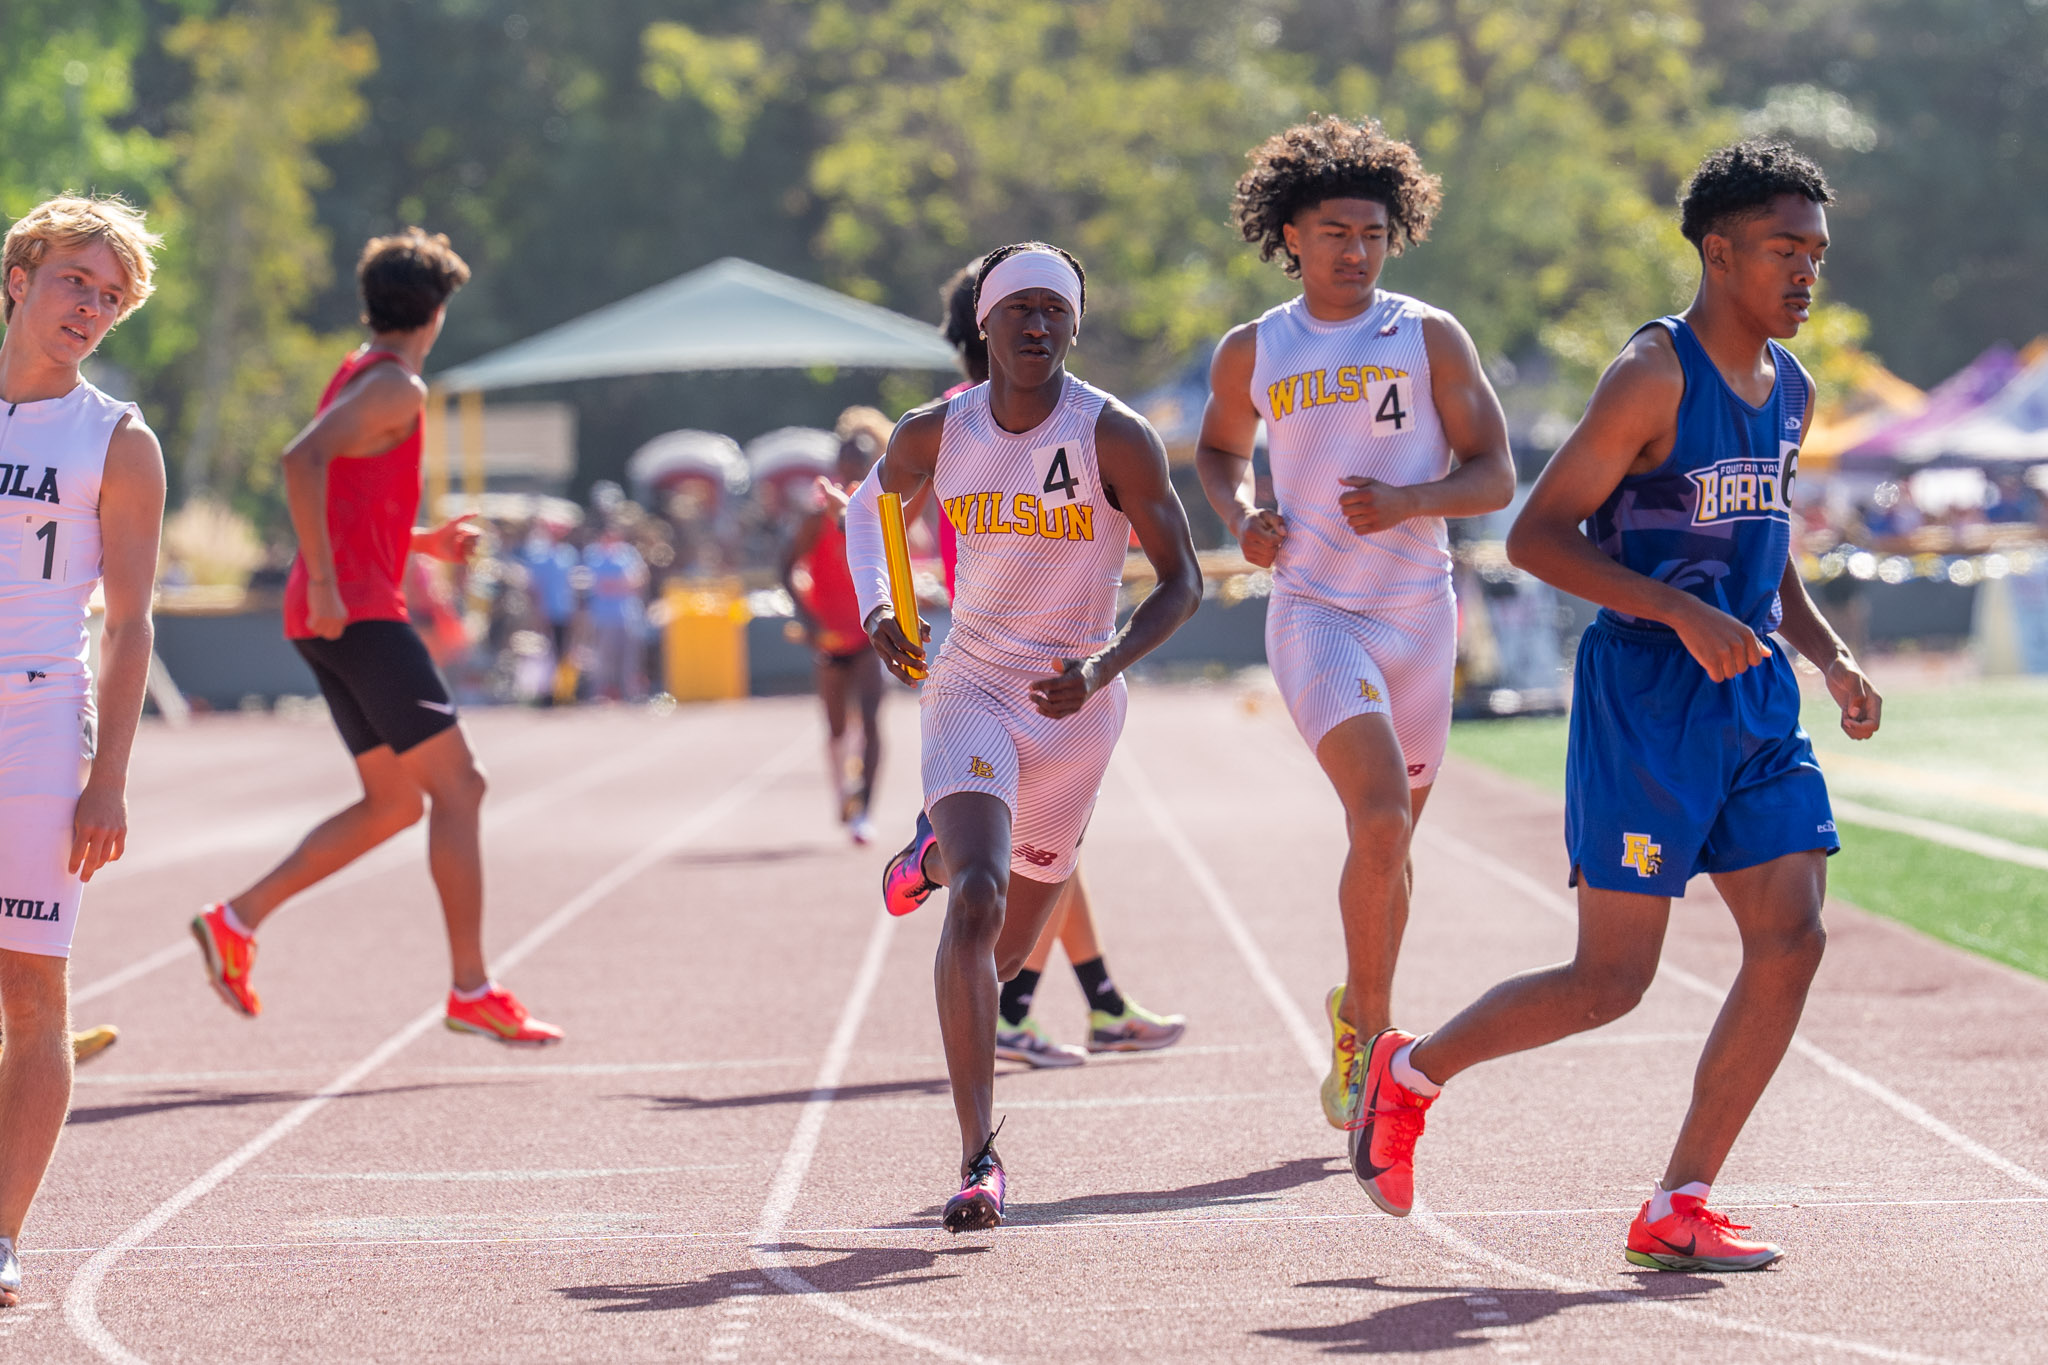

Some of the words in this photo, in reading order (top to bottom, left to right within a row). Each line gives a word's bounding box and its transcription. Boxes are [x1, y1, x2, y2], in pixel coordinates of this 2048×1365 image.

[1267, 365, 1409, 422] WILSO
[1375, 383, 1406, 430] 4
[1043, 447, 1079, 500] 4
[1781, 448, 1799, 508] 6
[944, 491, 1095, 542] WILSON
[36, 520, 58, 580] 1
[0, 896, 60, 922] YOLA
